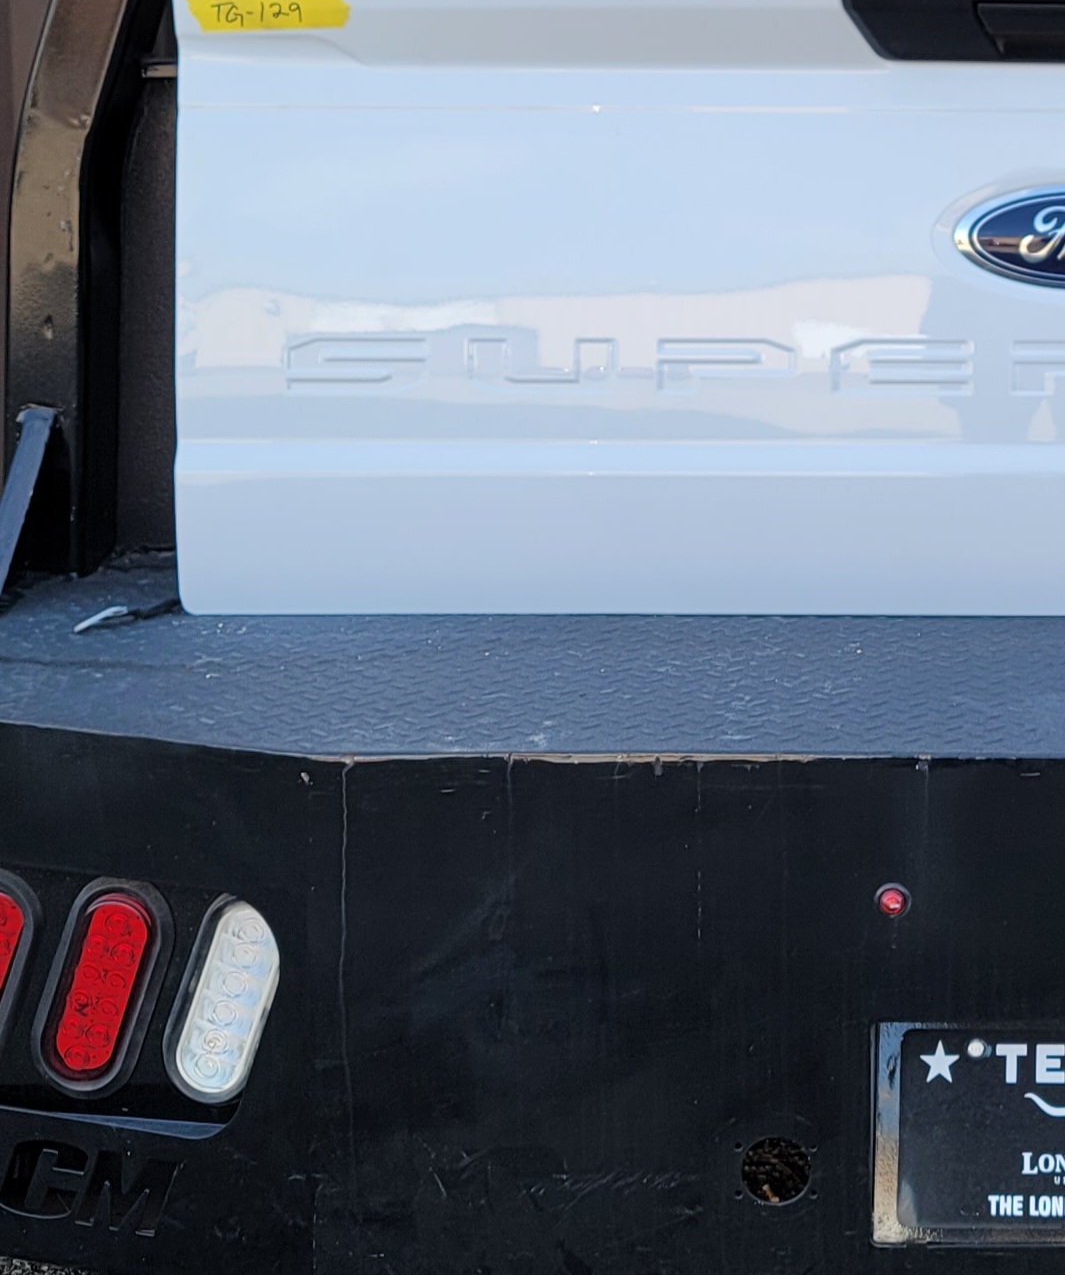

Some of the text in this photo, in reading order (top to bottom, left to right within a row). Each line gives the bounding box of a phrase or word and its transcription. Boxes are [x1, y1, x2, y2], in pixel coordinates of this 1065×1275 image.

[210, 2, 304, 27] TG-129
[0, 1140, 187, 1237] CM
[987, 1194, 1024, 1217] THE
